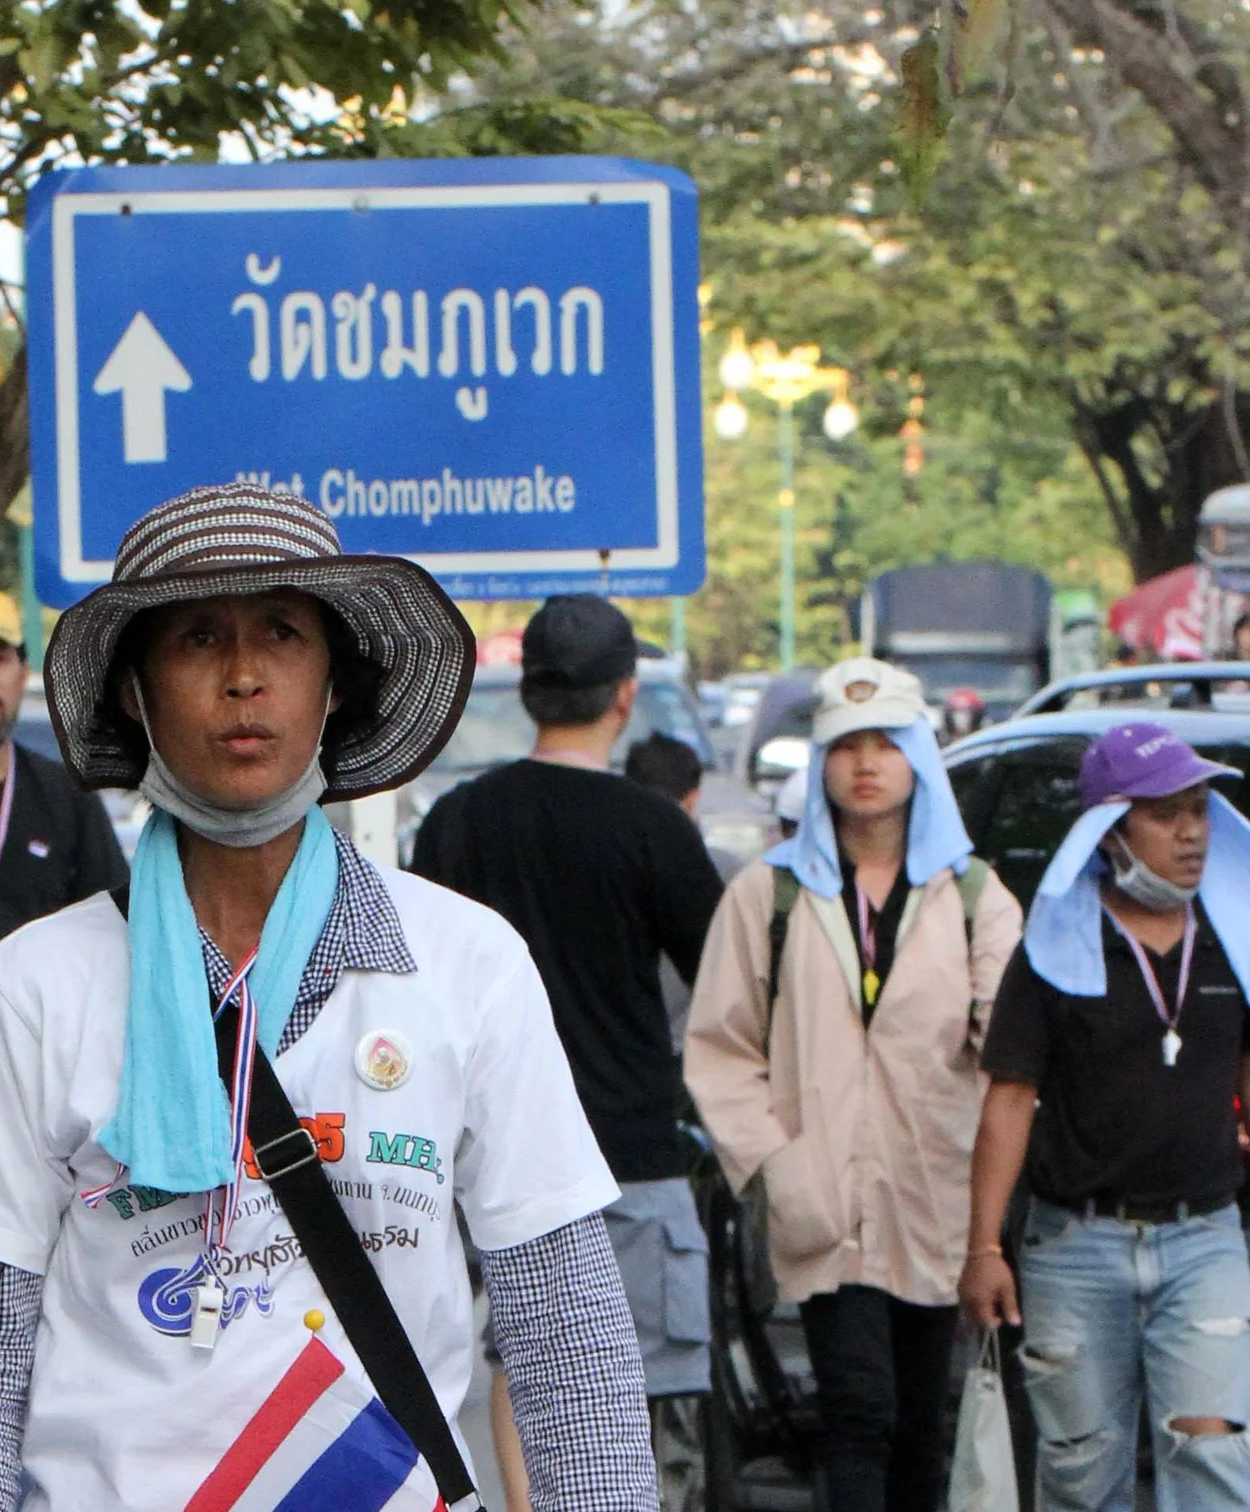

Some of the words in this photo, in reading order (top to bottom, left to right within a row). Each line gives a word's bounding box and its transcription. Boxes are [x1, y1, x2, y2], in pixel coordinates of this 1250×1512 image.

[232, 253, 603, 421] วัดชมภูเวก
[318, 465, 576, 526] Chomphuwake
